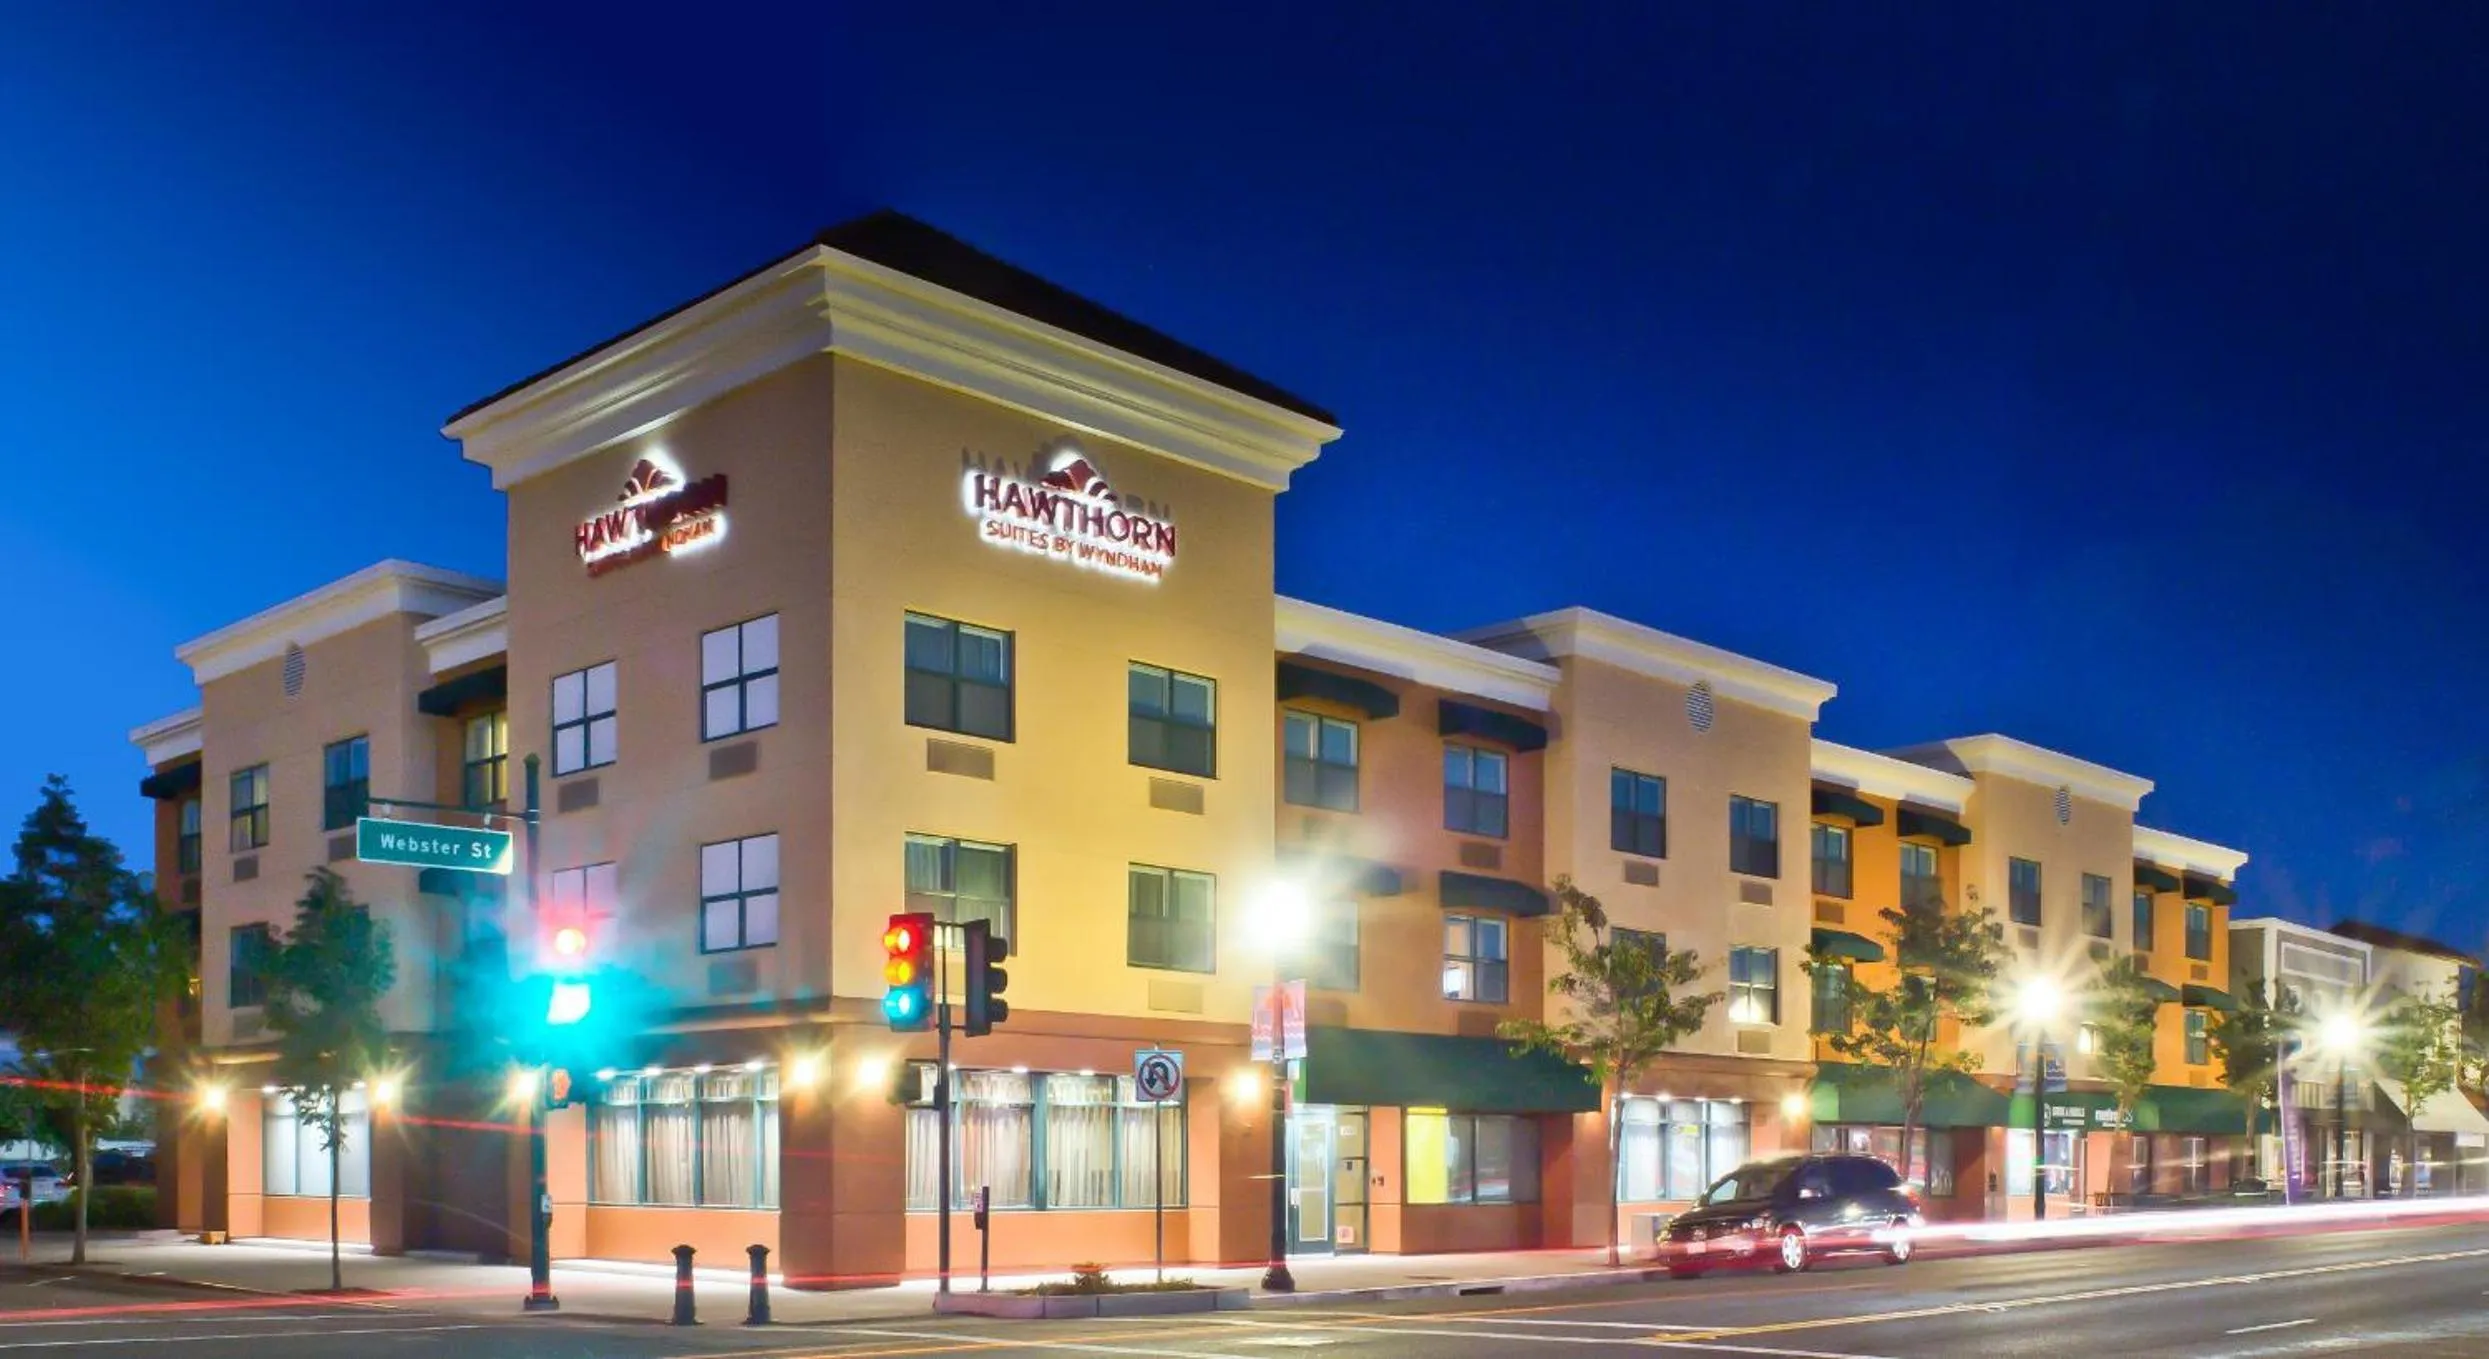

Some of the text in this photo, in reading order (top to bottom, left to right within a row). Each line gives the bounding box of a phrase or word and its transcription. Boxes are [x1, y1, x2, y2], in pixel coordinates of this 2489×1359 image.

[574, 473, 727, 556] HAWT
[974, 473, 1176, 557] HAWTHORN
[986, 520, 1163, 578] SUITES BY WYNDHAM
[380, 833, 492, 859] Webster St
